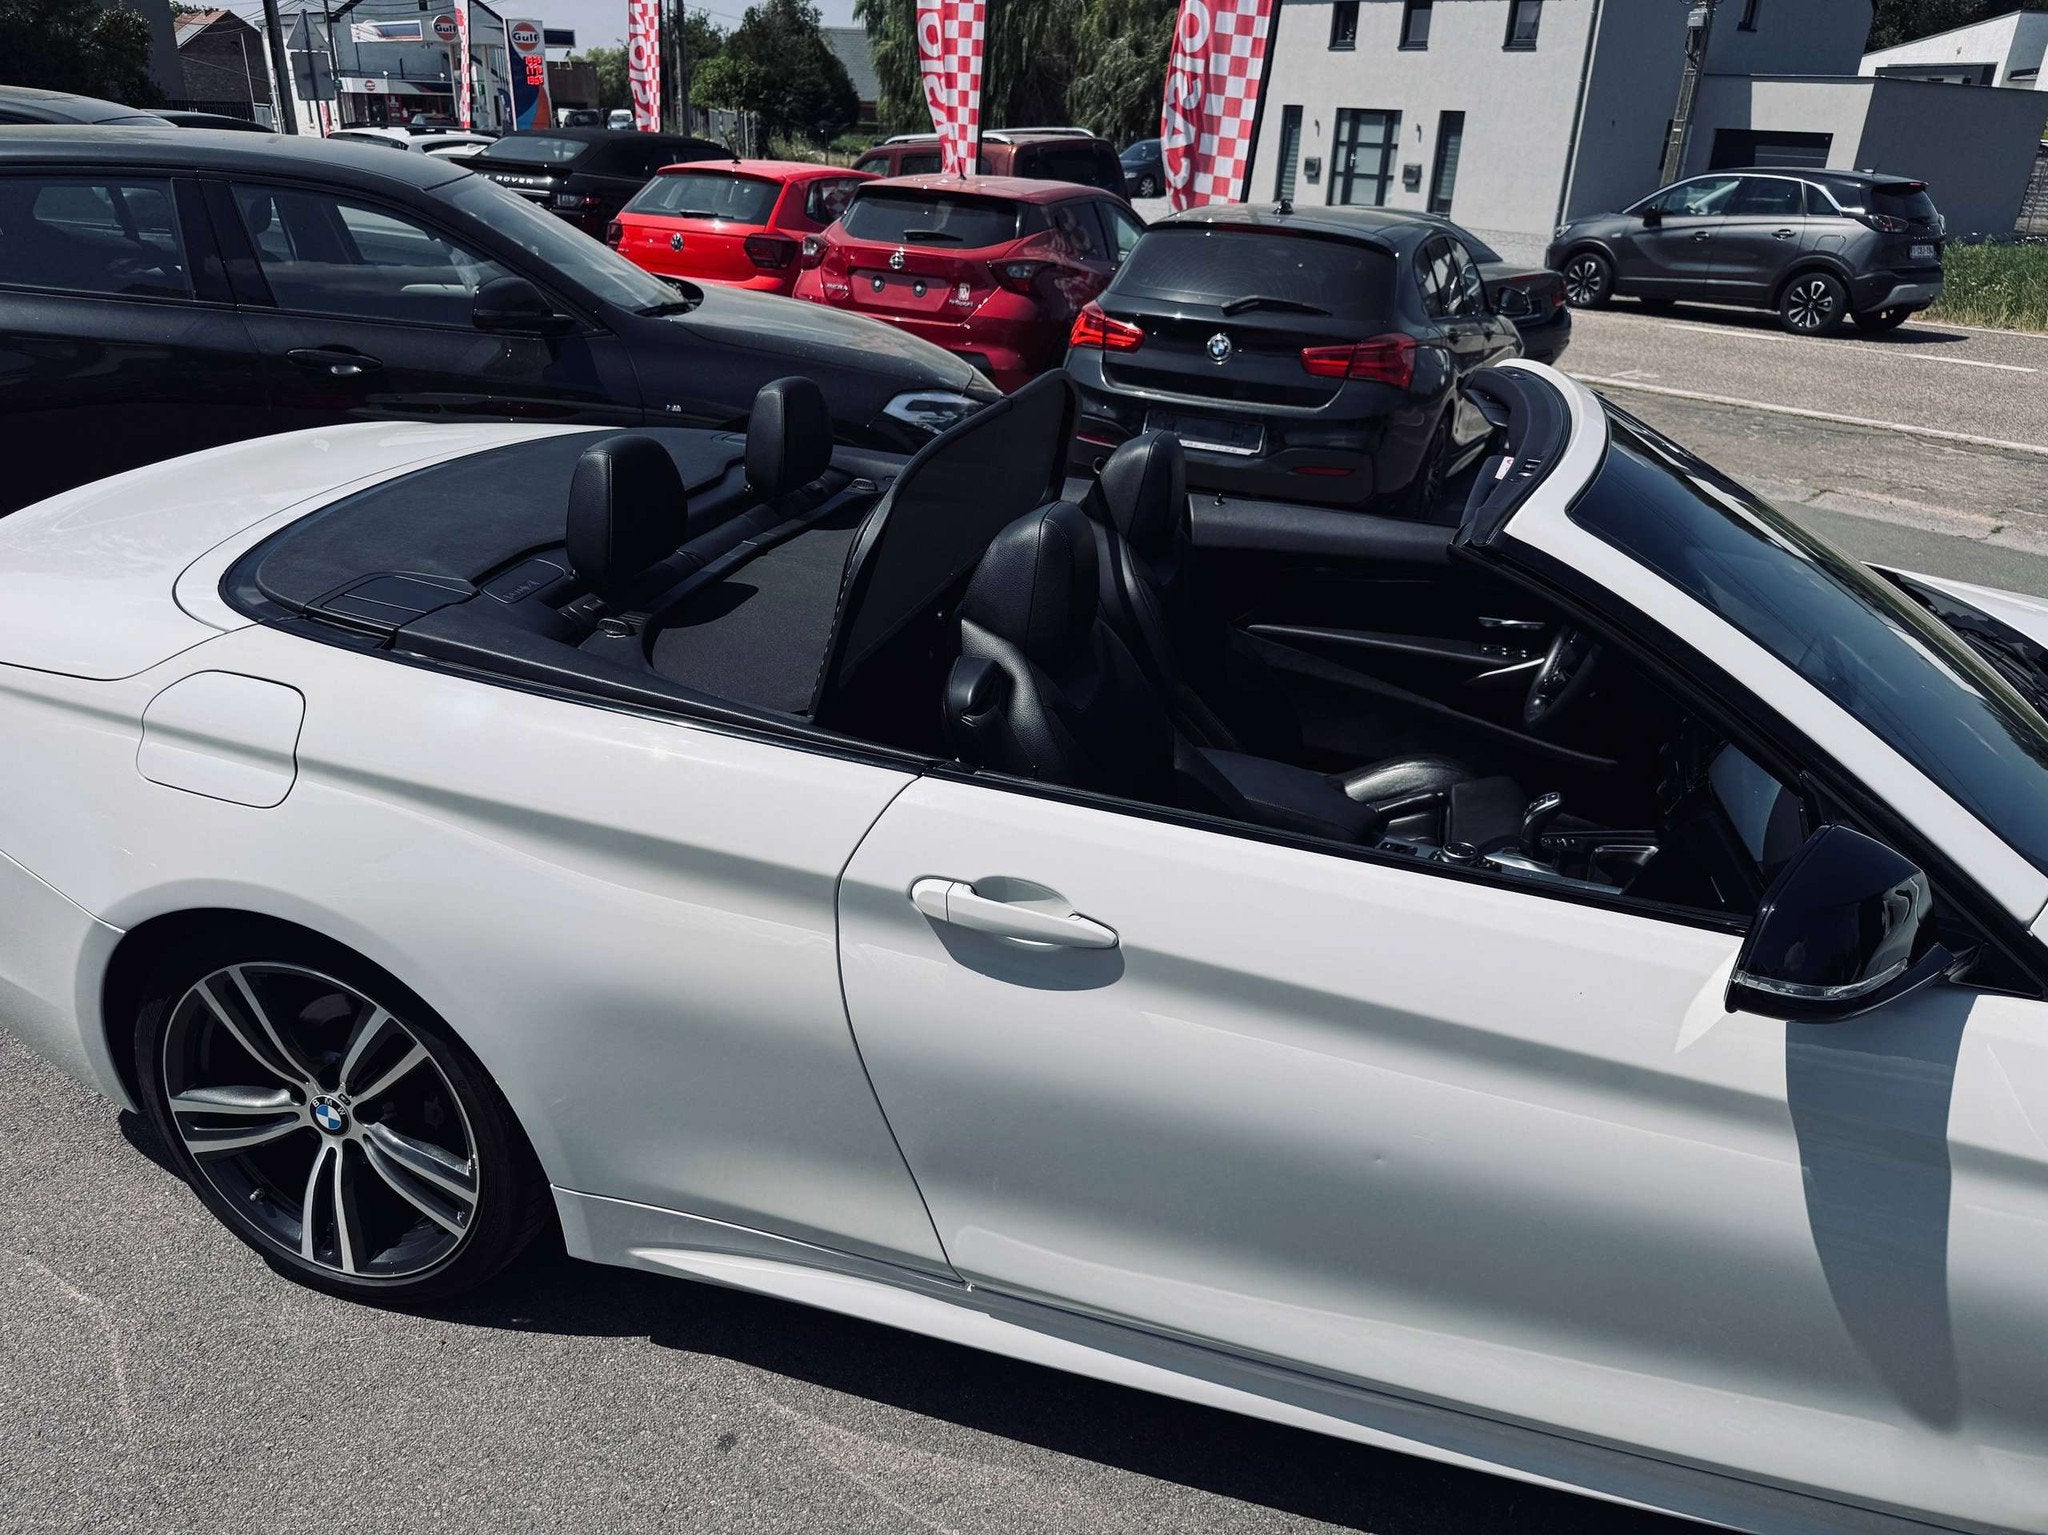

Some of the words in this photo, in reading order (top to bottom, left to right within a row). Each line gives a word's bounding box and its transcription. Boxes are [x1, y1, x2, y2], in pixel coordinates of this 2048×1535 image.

[434, 24, 457, 33] Gulf
[513, 32, 539, 42] Gulf
[495, 175, 534, 185] ROVER
[312, 1098, 346, 1115] BMW
